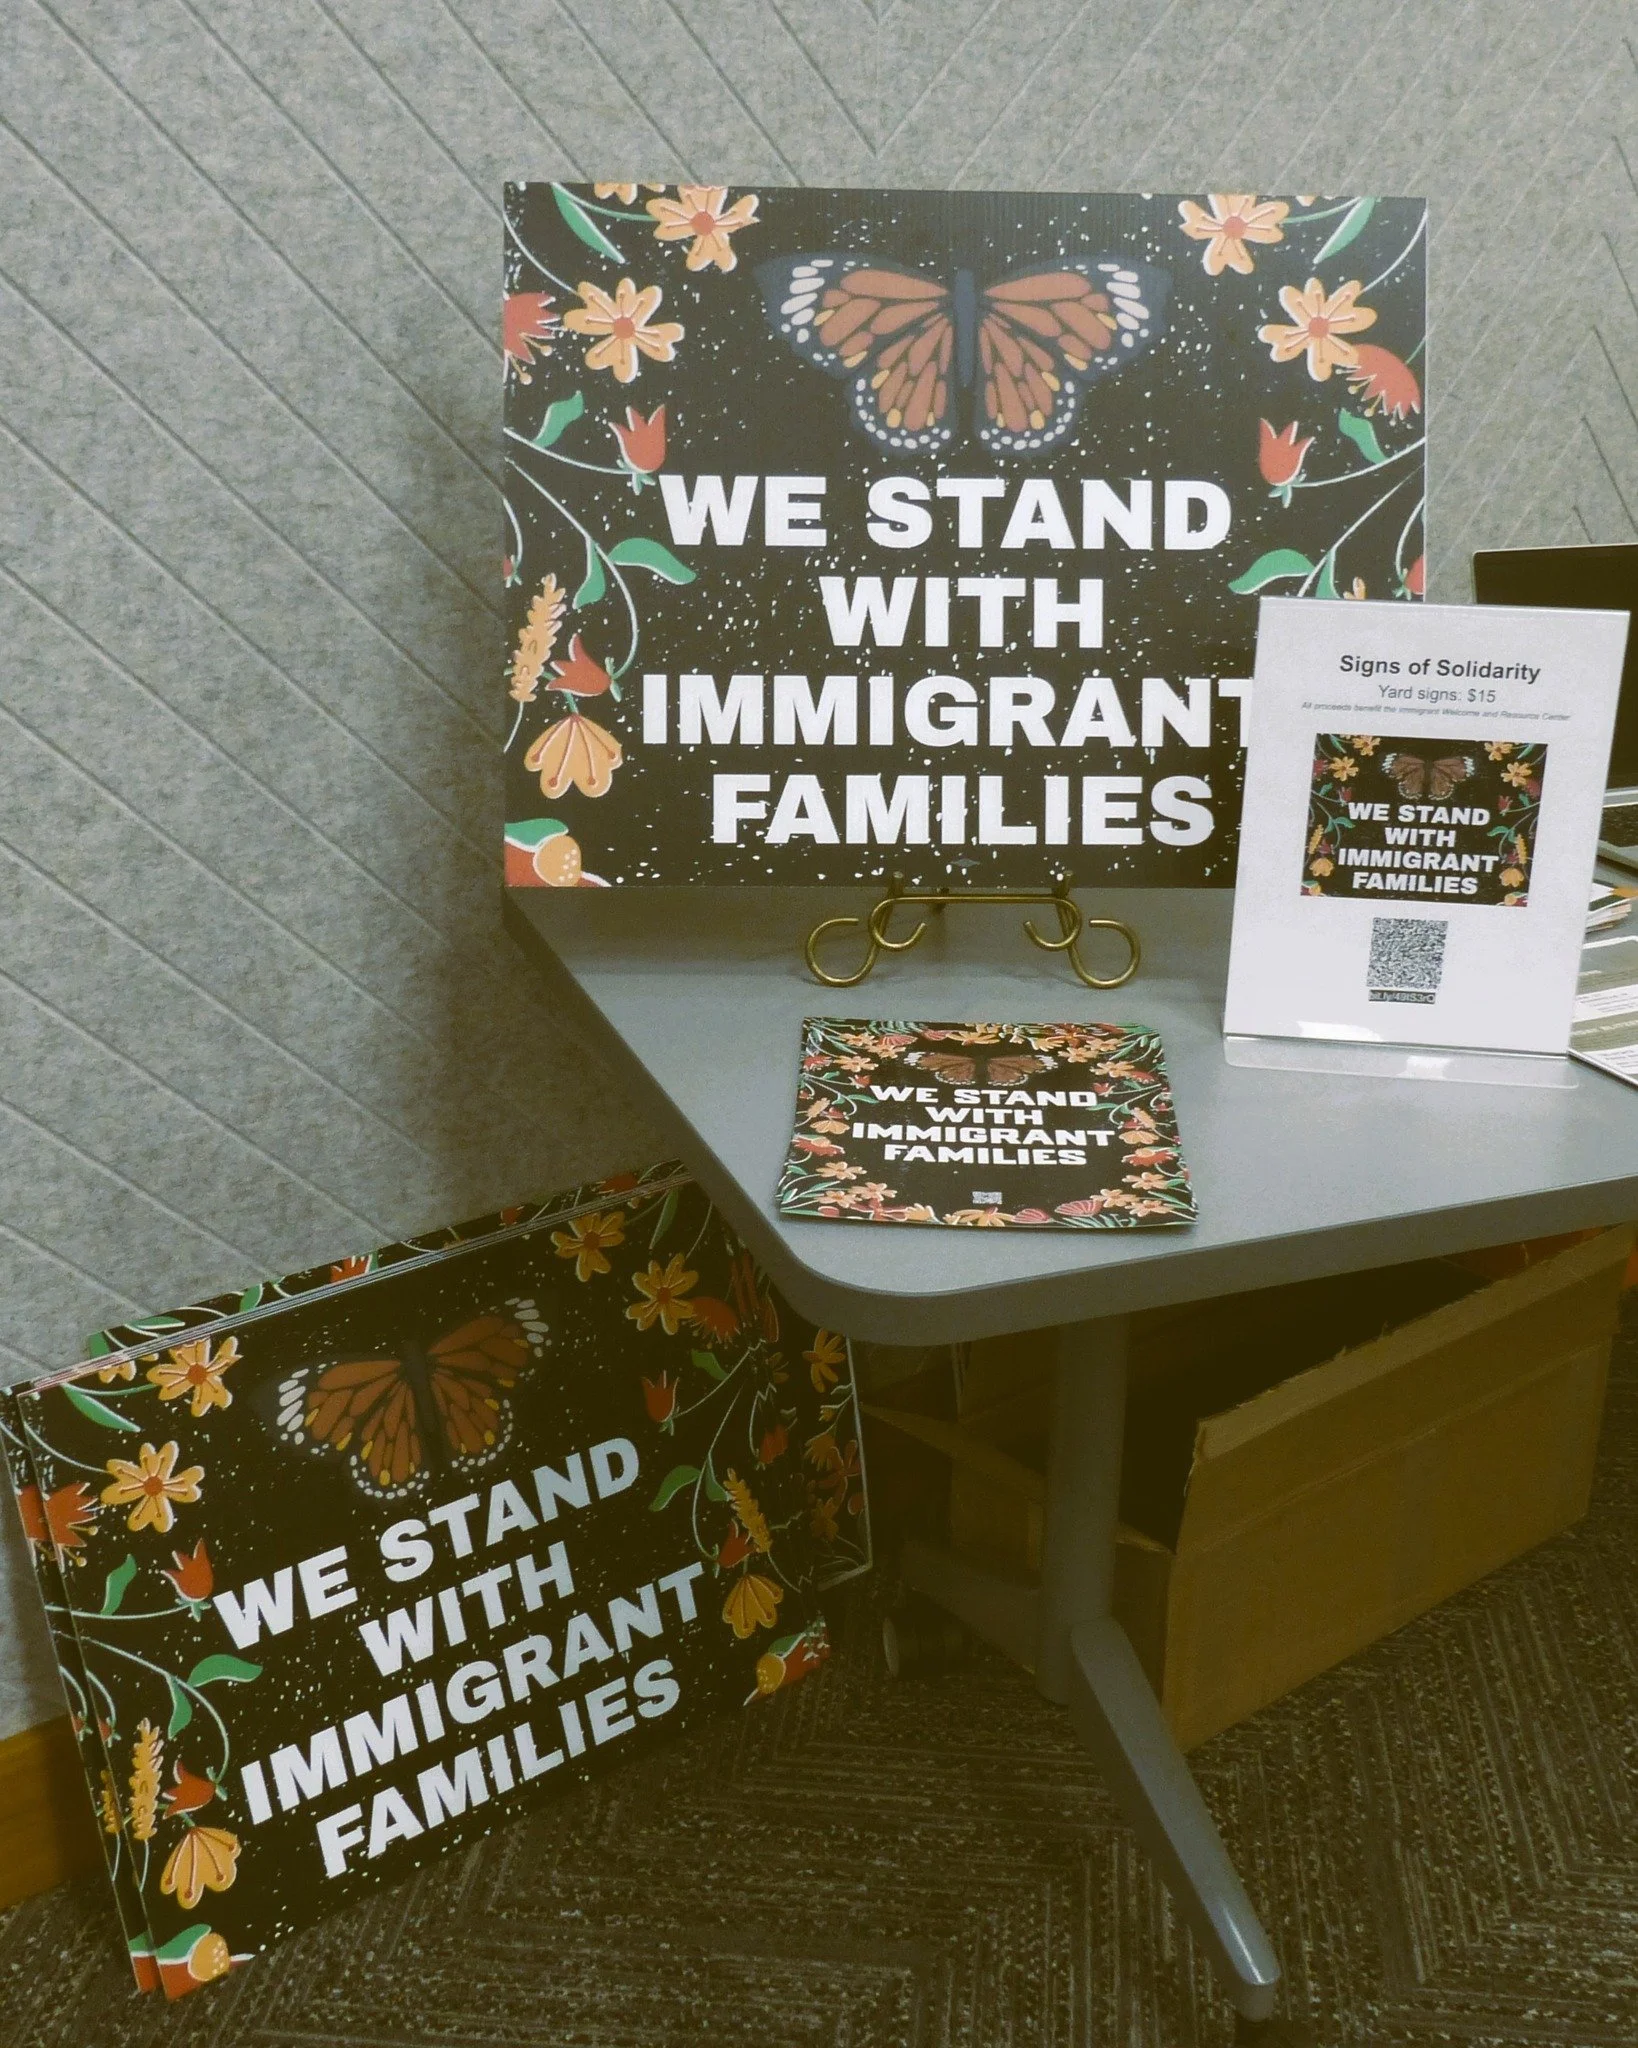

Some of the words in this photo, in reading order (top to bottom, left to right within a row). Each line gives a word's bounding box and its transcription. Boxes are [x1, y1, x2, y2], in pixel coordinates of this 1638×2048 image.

[658, 474, 827, 547] WE
[866, 476, 1232, 551] STAND
[818, 576, 1104, 649] WITH
[1340, 655, 1400, 678] Signs
[1408, 659, 1430, 676] of
[1436, 659, 1541, 685] Solidarity
[1378, 684, 1413, 700] Yard
[1417, 686, 1463, 703] signs:
[1467, 688, 1497, 703] $15
[1314, 703, 1352, 711] proceeds
[1442, 708, 1480, 717] Welcome
[1482, 710, 1499, 718] and
[710, 773, 1215, 846] FAMILIES
[1347, 802, 1390, 822] WE
[1397, 804, 1491, 826] STAND
[1384, 827, 1457, 848] WITH
[1337, 847, 1500, 873] IMMIGRANT
[1352, 871, 1479, 896] FAMILIES
[869, 1085, 939, 1103] WE
[953, 1088, 1098, 1107] STAND
[924, 1106, 1044, 1126] WITH
[852, 1122, 1116, 1147] IMMIGRANT
[884, 1143, 1087, 1166] FAMILIES
[212, 1545, 359, 1650] WE
[379, 1437, 640, 1583] STAND
[358, 1540, 575, 1677] WITH
[240, 1561, 705, 1826] IMMIGRANT
[315, 1659, 682, 1880] FAMILIES
